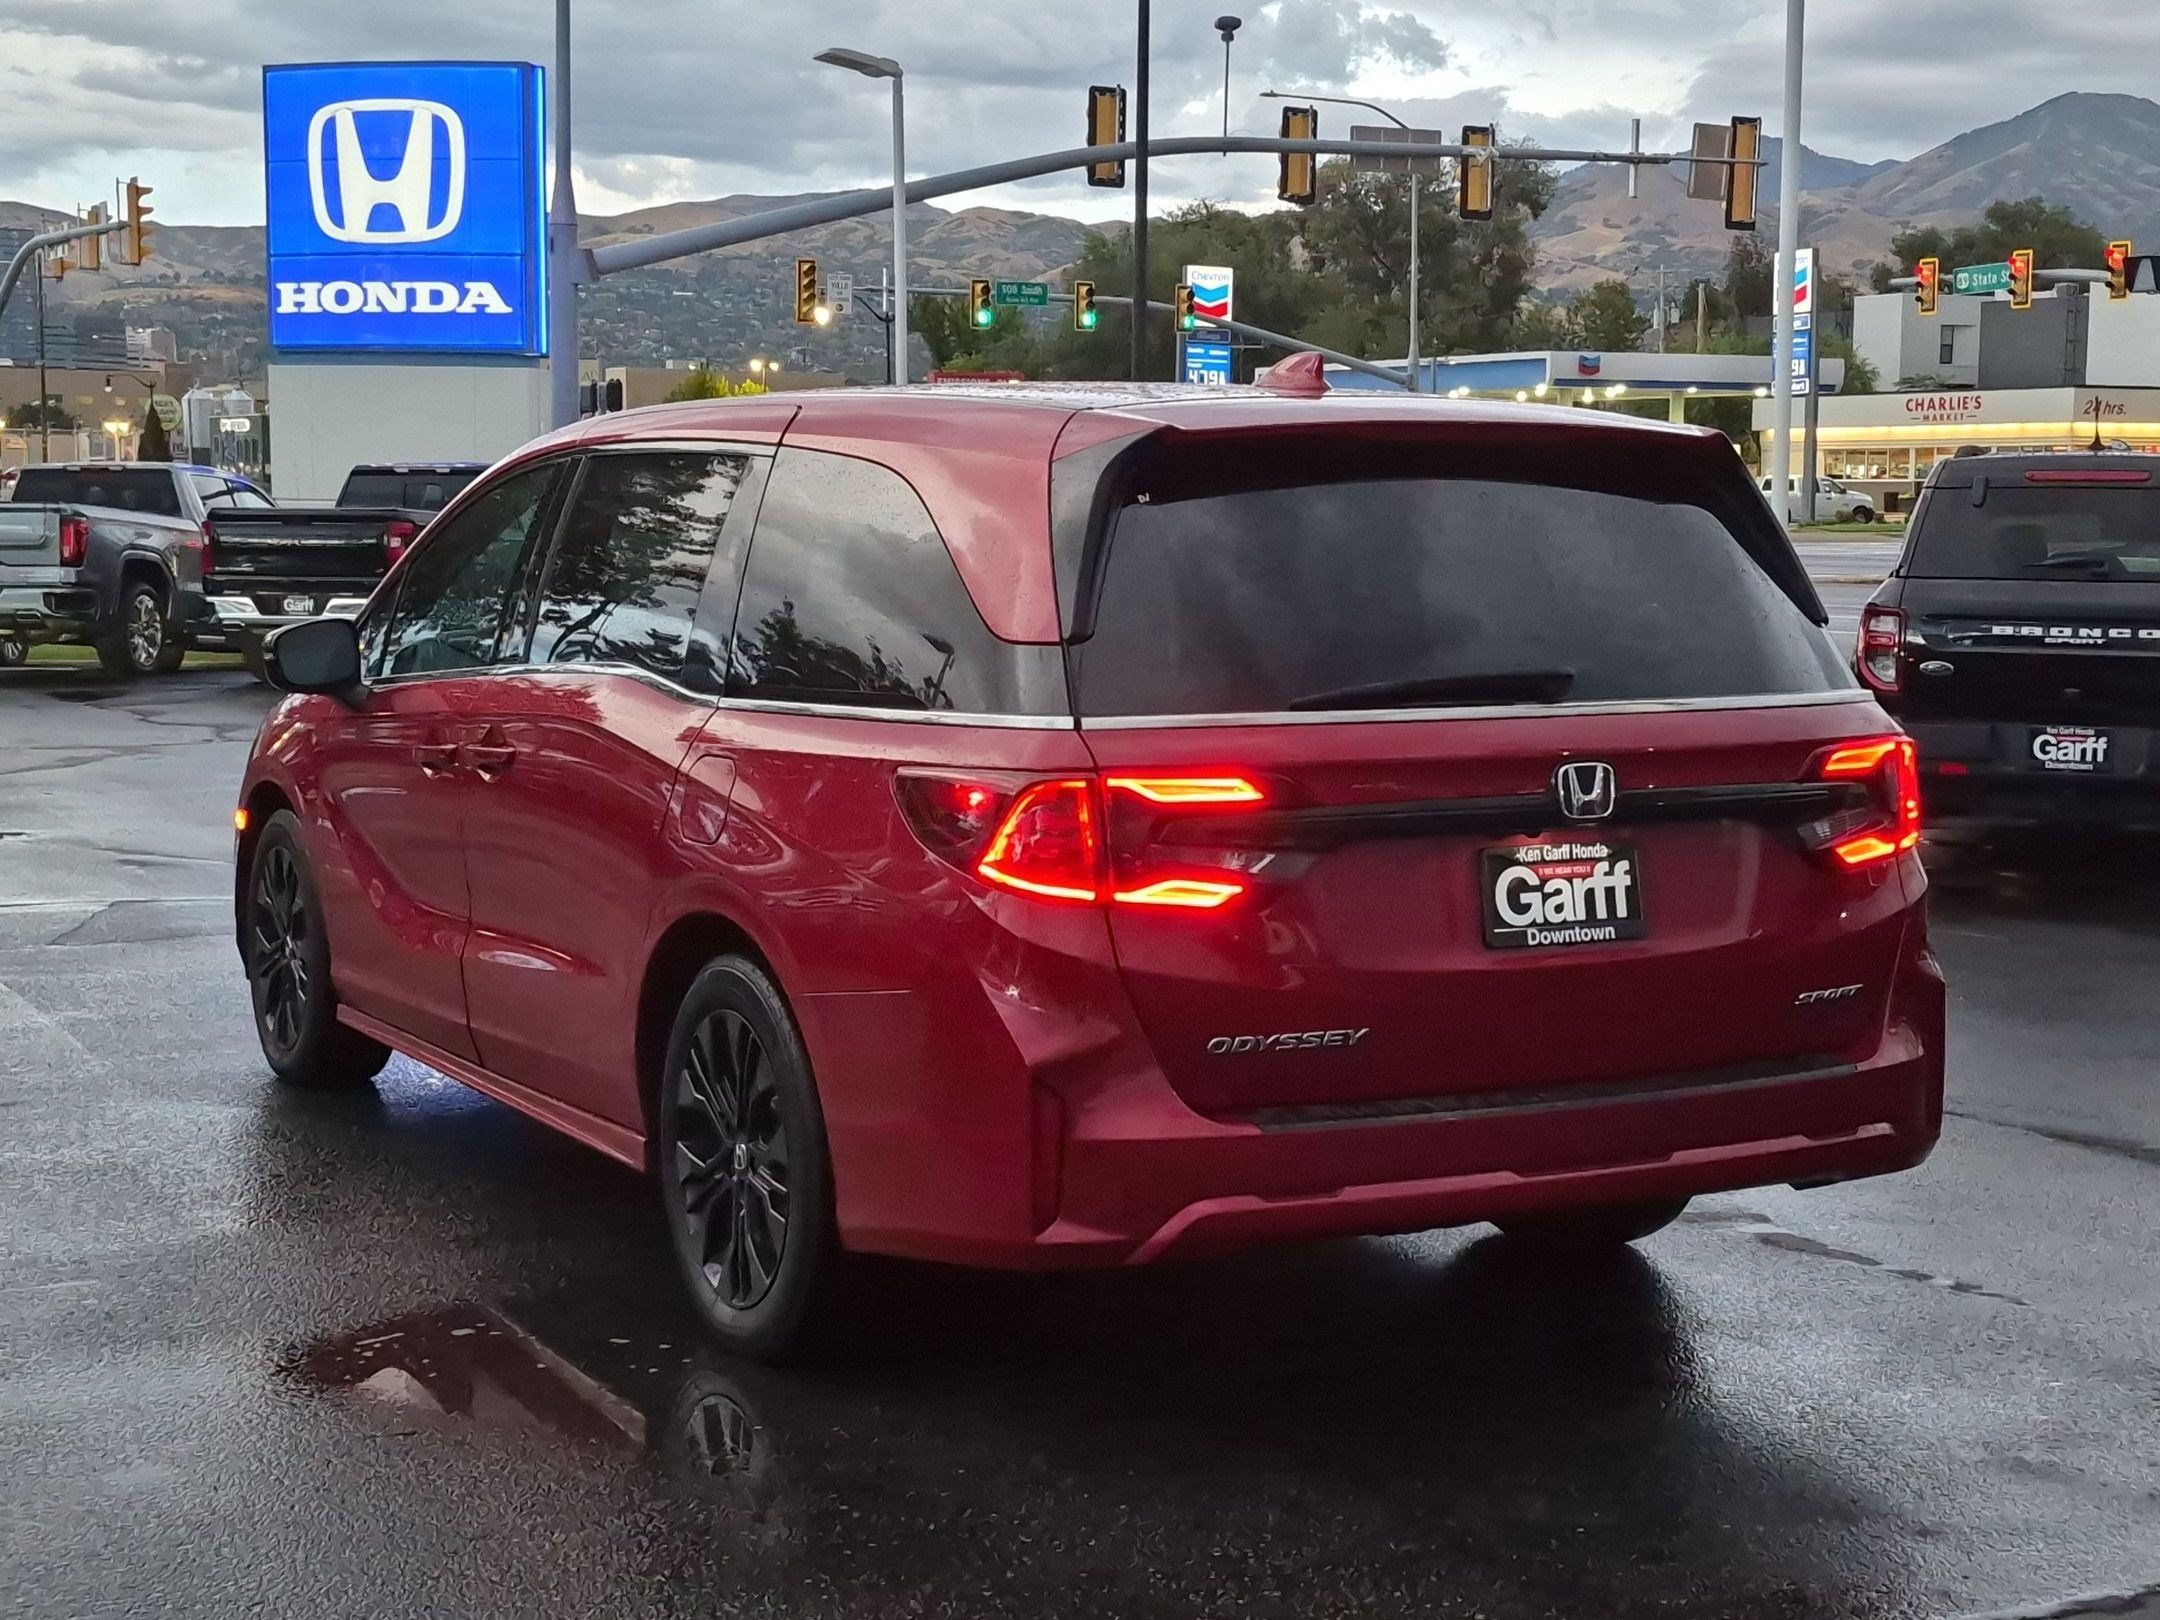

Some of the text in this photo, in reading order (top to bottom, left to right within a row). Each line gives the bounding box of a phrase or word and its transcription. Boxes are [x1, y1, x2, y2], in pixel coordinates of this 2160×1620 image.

[1191, 271, 1230, 281] Chevron
[1972, 272, 1998, 286] State
[276, 281, 513, 314] HONDA
[1905, 395, 1982, 412] CHARLIE'S
[2082, 399, 2127, 415] 24 hrs.
[1922, 413, 1965, 422] MARKET
[283, 598, 314, 612] Garff
[1991, 625, 2160, 639] BRONCO
[2044, 637, 2107, 645] SPORT
[2033, 734, 2108, 762] Garff
[1519, 842, 1609, 862] Ken Garff Honda
[1495, 859, 1631, 928] Garff
[1526, 926, 1616, 946] Downtown
[1207, 1028, 1370, 1054] ODYSSEY
